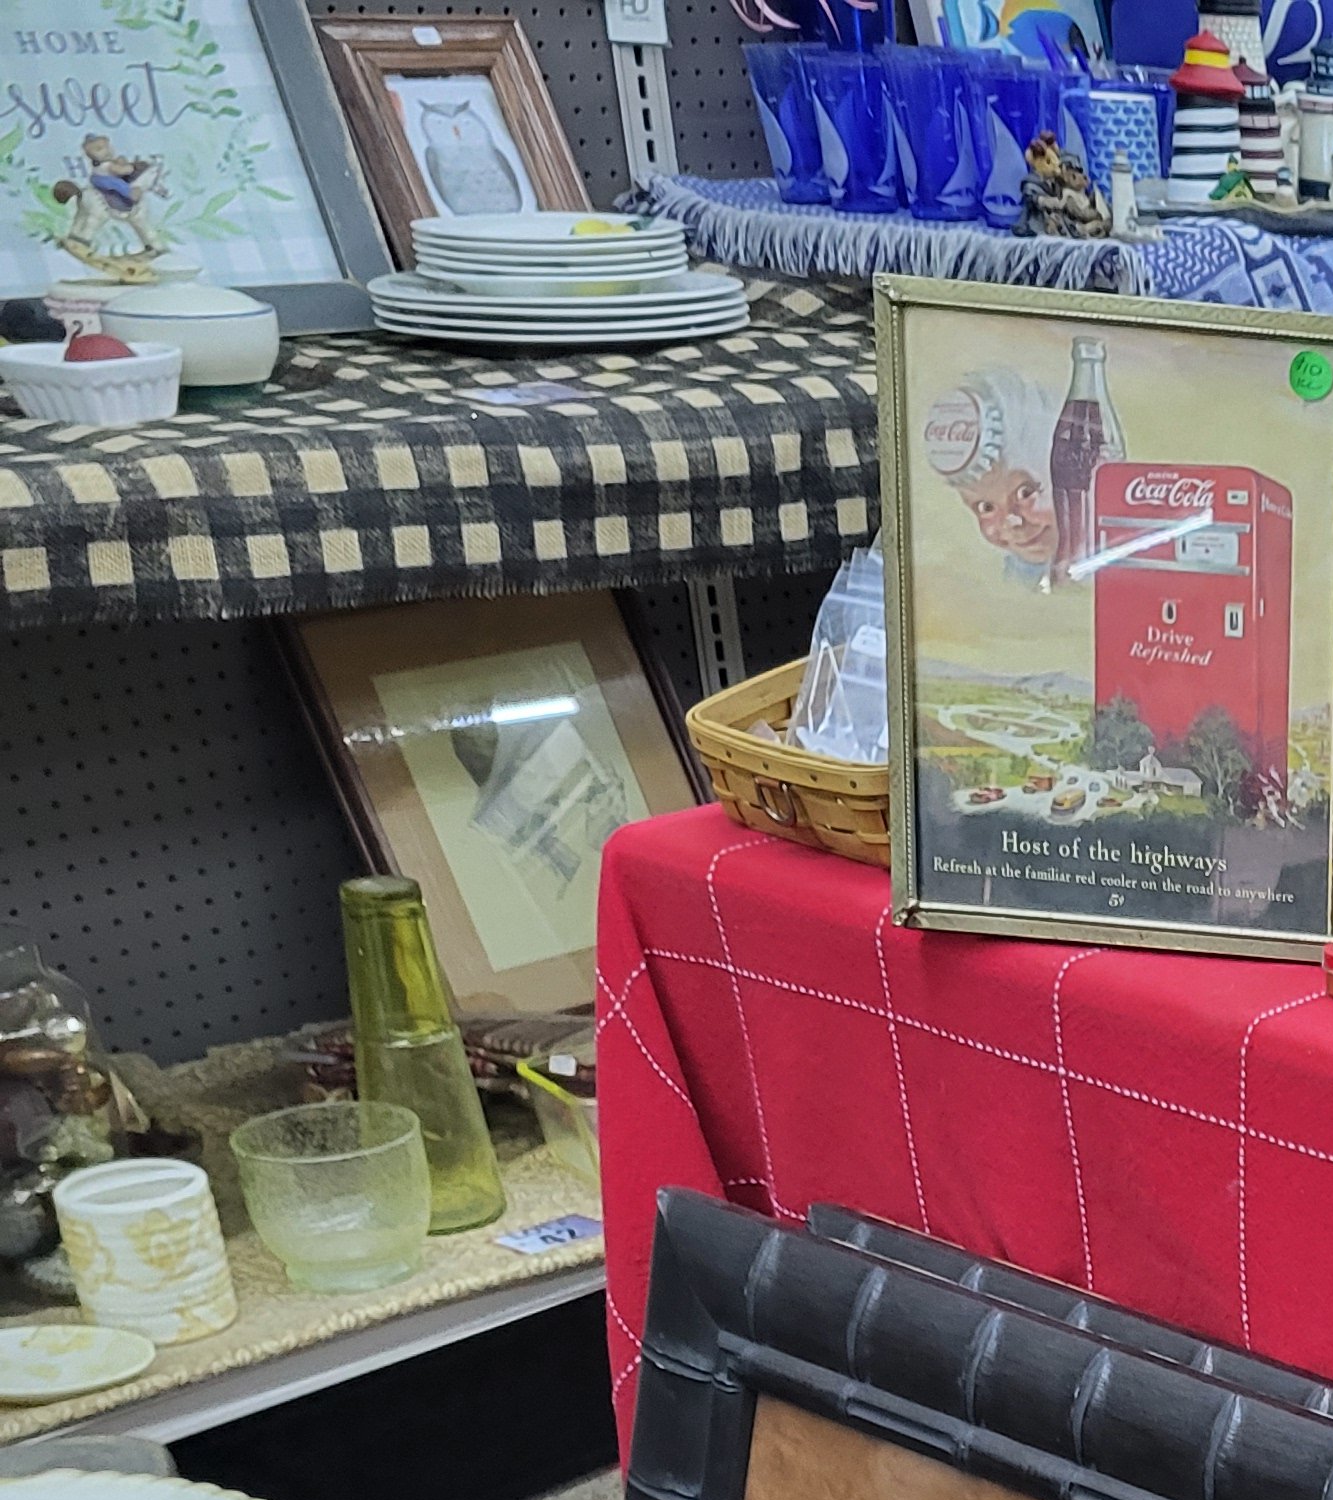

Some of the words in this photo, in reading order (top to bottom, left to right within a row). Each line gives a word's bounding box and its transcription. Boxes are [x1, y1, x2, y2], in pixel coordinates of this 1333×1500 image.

[14, 30, 126, 55] HOME
[0, 61, 192, 140] sweet
[1130, 641, 1213, 666] Refreshed
[1147, 625, 1195, 646] Drive
[1001, 830, 1050, 856] Host
[1058, 836, 1082, 859] of
[1088, 838, 1121, 862] the
[1130, 840, 1228, 877] highways
[933, 856, 982, 875] Refresh
[985, 865, 998, 877] at
[1001, 863, 1022, 879] the
[1025, 865, 1072, 884] familiar
[1075, 871, 1096, 886] red
[1100, 874, 1137, 890] cooler
[1141, 880, 1158, 891] on
[1162, 877, 1182, 893] the
[1186, 882, 1215, 896] road
[1218, 886, 1232, 897] to
[1235, 887, 1295, 904] anywhere
